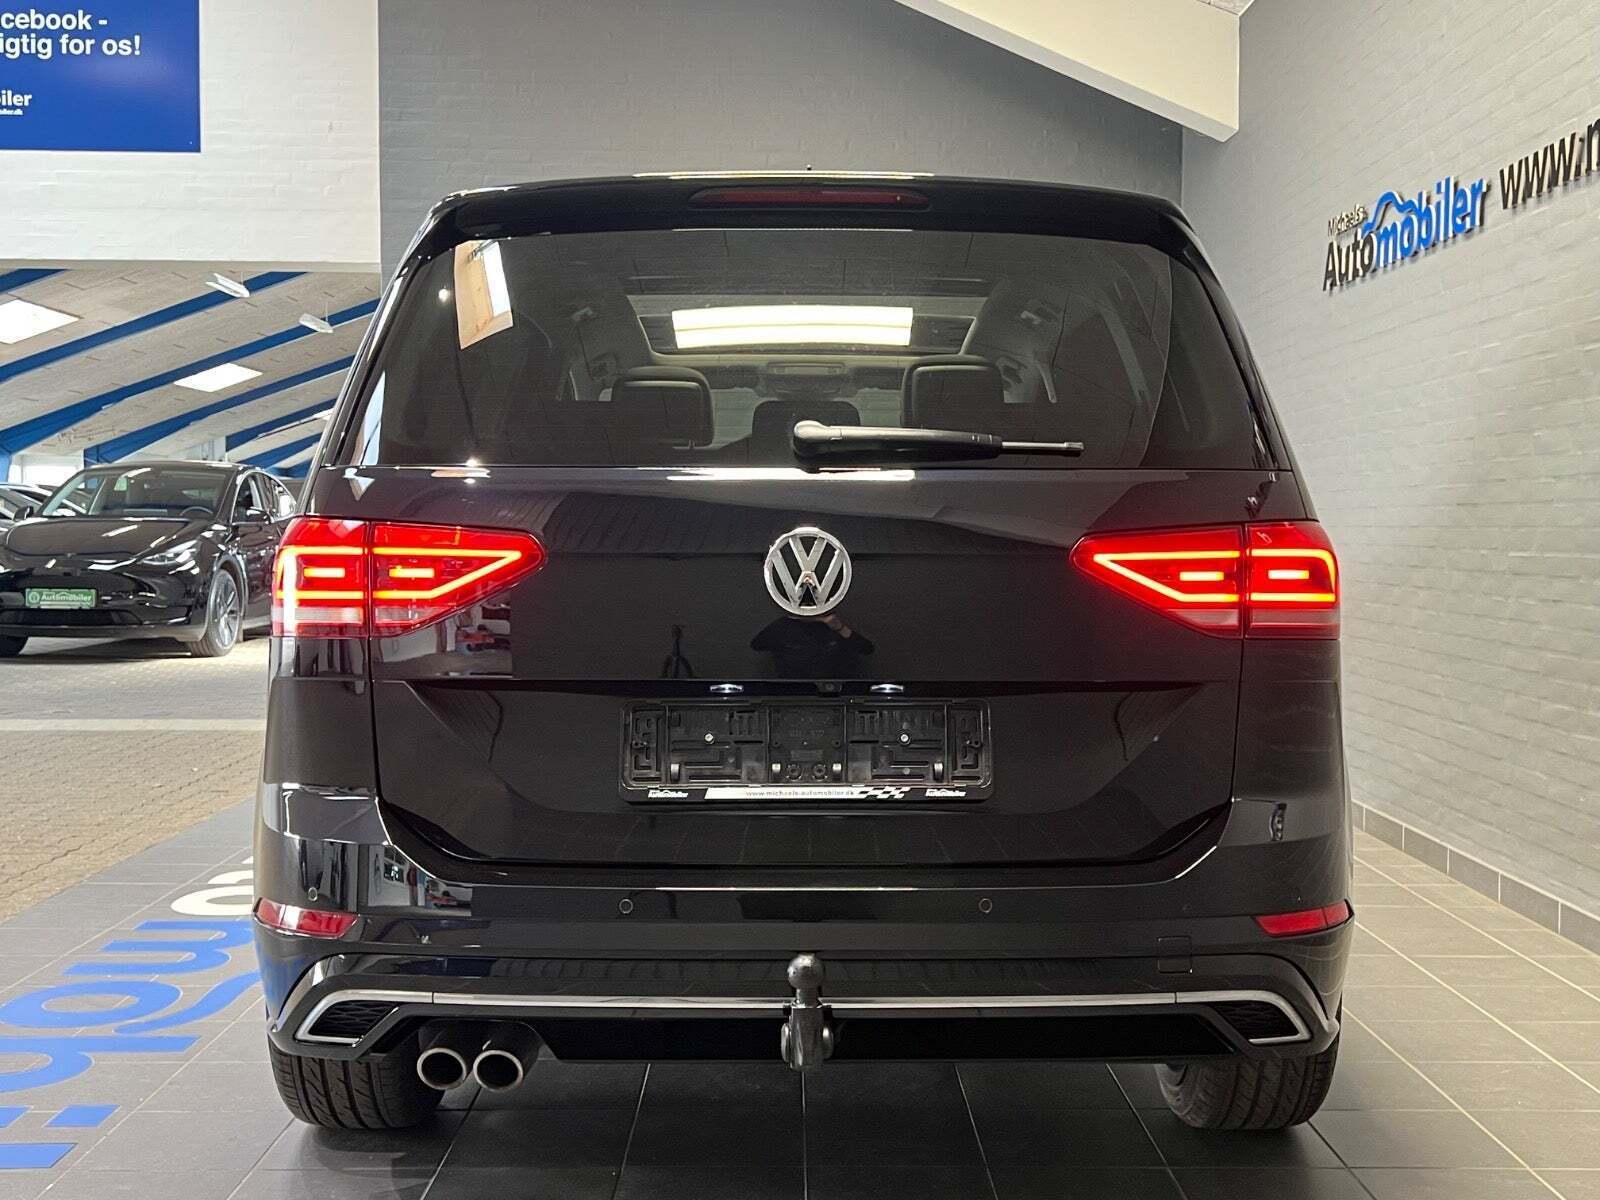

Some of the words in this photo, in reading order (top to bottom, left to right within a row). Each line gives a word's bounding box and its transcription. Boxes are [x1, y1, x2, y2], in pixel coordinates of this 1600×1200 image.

[0, 9, 92, 30] cebook
[60, 34, 96, 55] for
[101, 35, 142, 56] os!
[0, 89, 33, 107] iler
[1322, 175, 1488, 292] Automobiler
